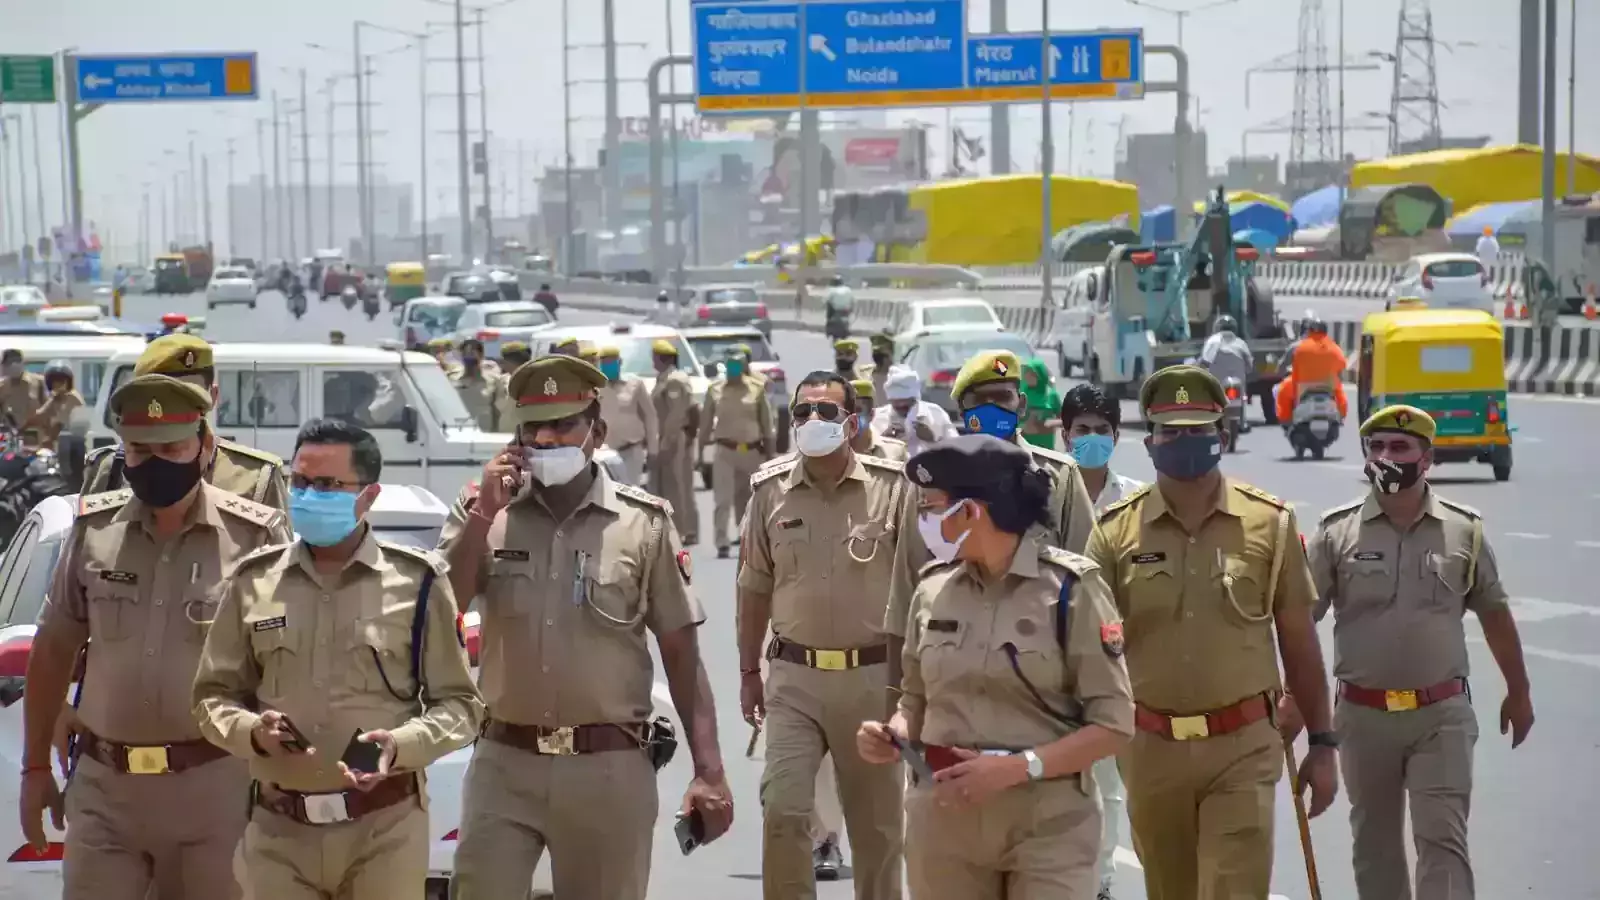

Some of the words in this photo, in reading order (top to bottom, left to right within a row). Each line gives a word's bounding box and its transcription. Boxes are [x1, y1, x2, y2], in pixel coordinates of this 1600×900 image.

[845, 8, 936, 27] Ghaziabad
[845, 36, 953, 54] Bulandshahr
[847, 66, 899, 84] Noida
[975, 65, 1037, 84] Meerut
